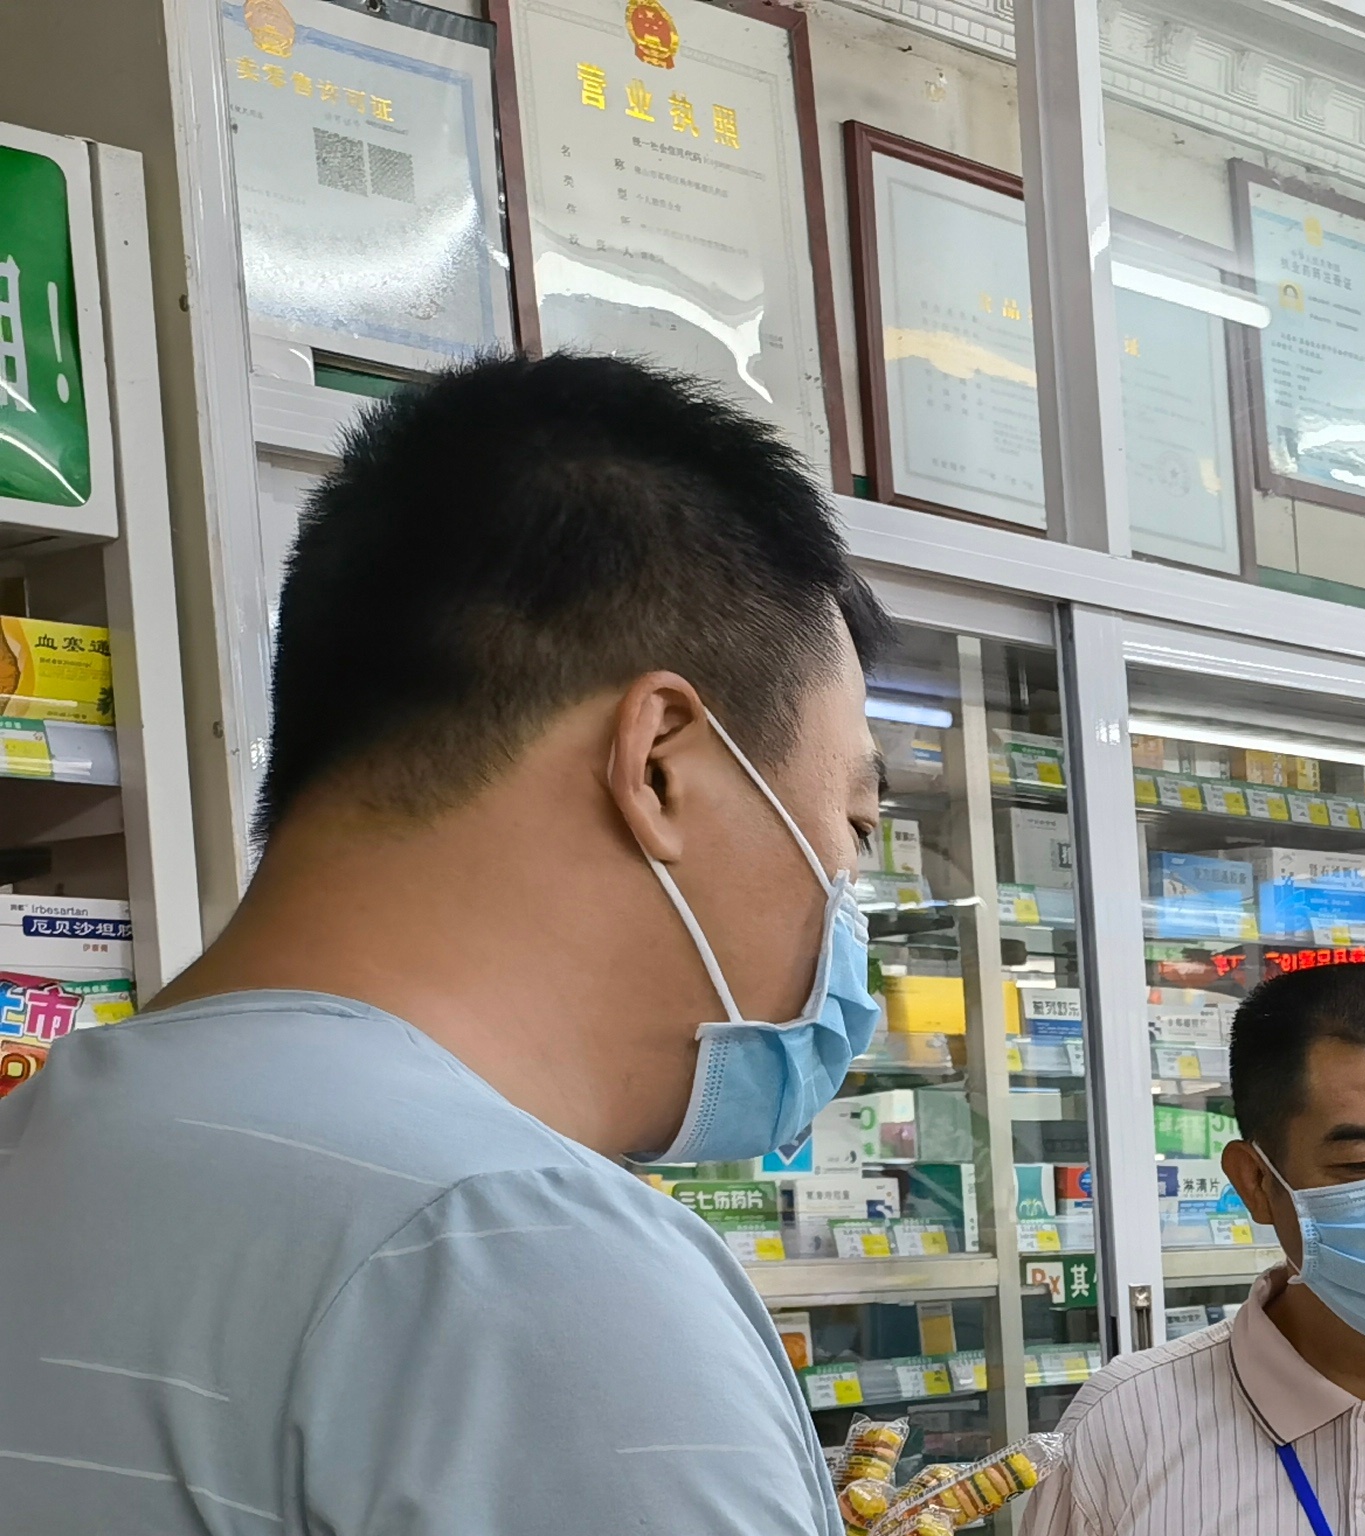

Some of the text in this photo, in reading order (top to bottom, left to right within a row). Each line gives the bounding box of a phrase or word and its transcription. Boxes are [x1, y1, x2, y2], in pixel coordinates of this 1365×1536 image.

[226, 55, 395, 123] 卖零售许可证
[576, 62, 741, 150] 营业执照
[31, 903, 89, 917] Irbesartan
[678, 1190, 764, 1210] 三七伤药片
[1070, 1263, 1096, 1298] 其
